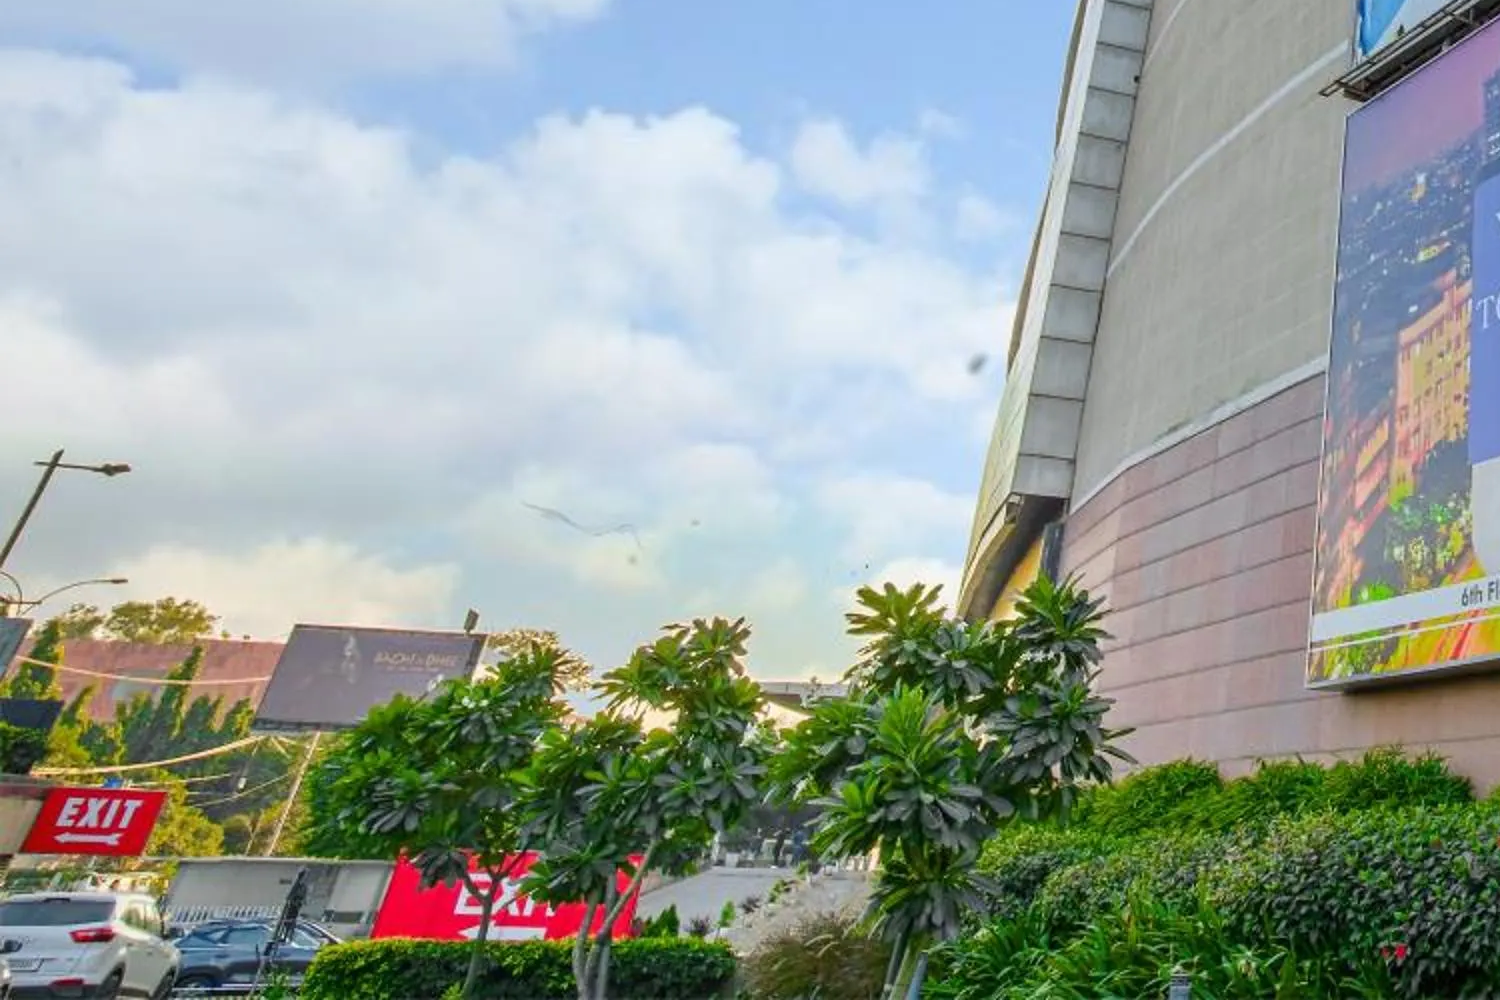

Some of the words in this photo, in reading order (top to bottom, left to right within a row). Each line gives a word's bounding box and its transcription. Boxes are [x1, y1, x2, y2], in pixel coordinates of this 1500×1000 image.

[1460, 581, 1483, 608] 6th
[55, 796, 144, 829] EXIT
[454, 872, 560, 917] EXI
